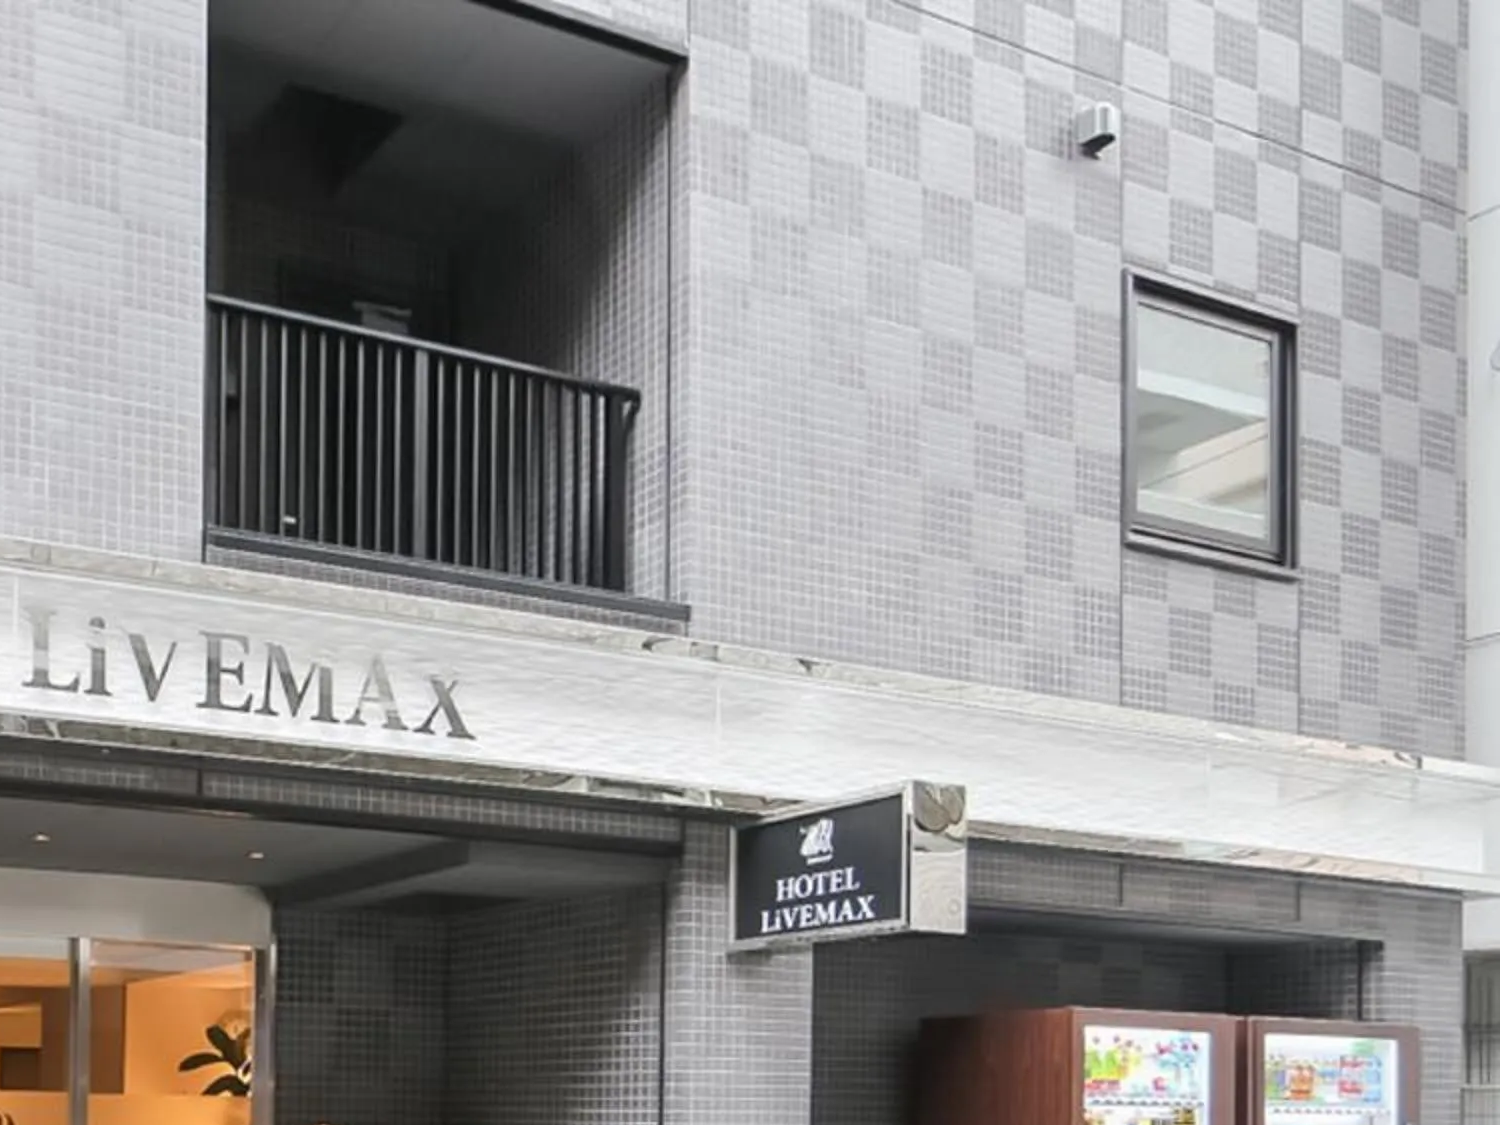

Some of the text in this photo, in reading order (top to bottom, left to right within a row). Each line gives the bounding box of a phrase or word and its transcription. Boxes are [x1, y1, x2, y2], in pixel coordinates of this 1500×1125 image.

[21, 605, 476, 740] LiVEMAX
[776, 867, 861, 902] HOTEL
[760, 895, 876, 933] LiVEMAX
